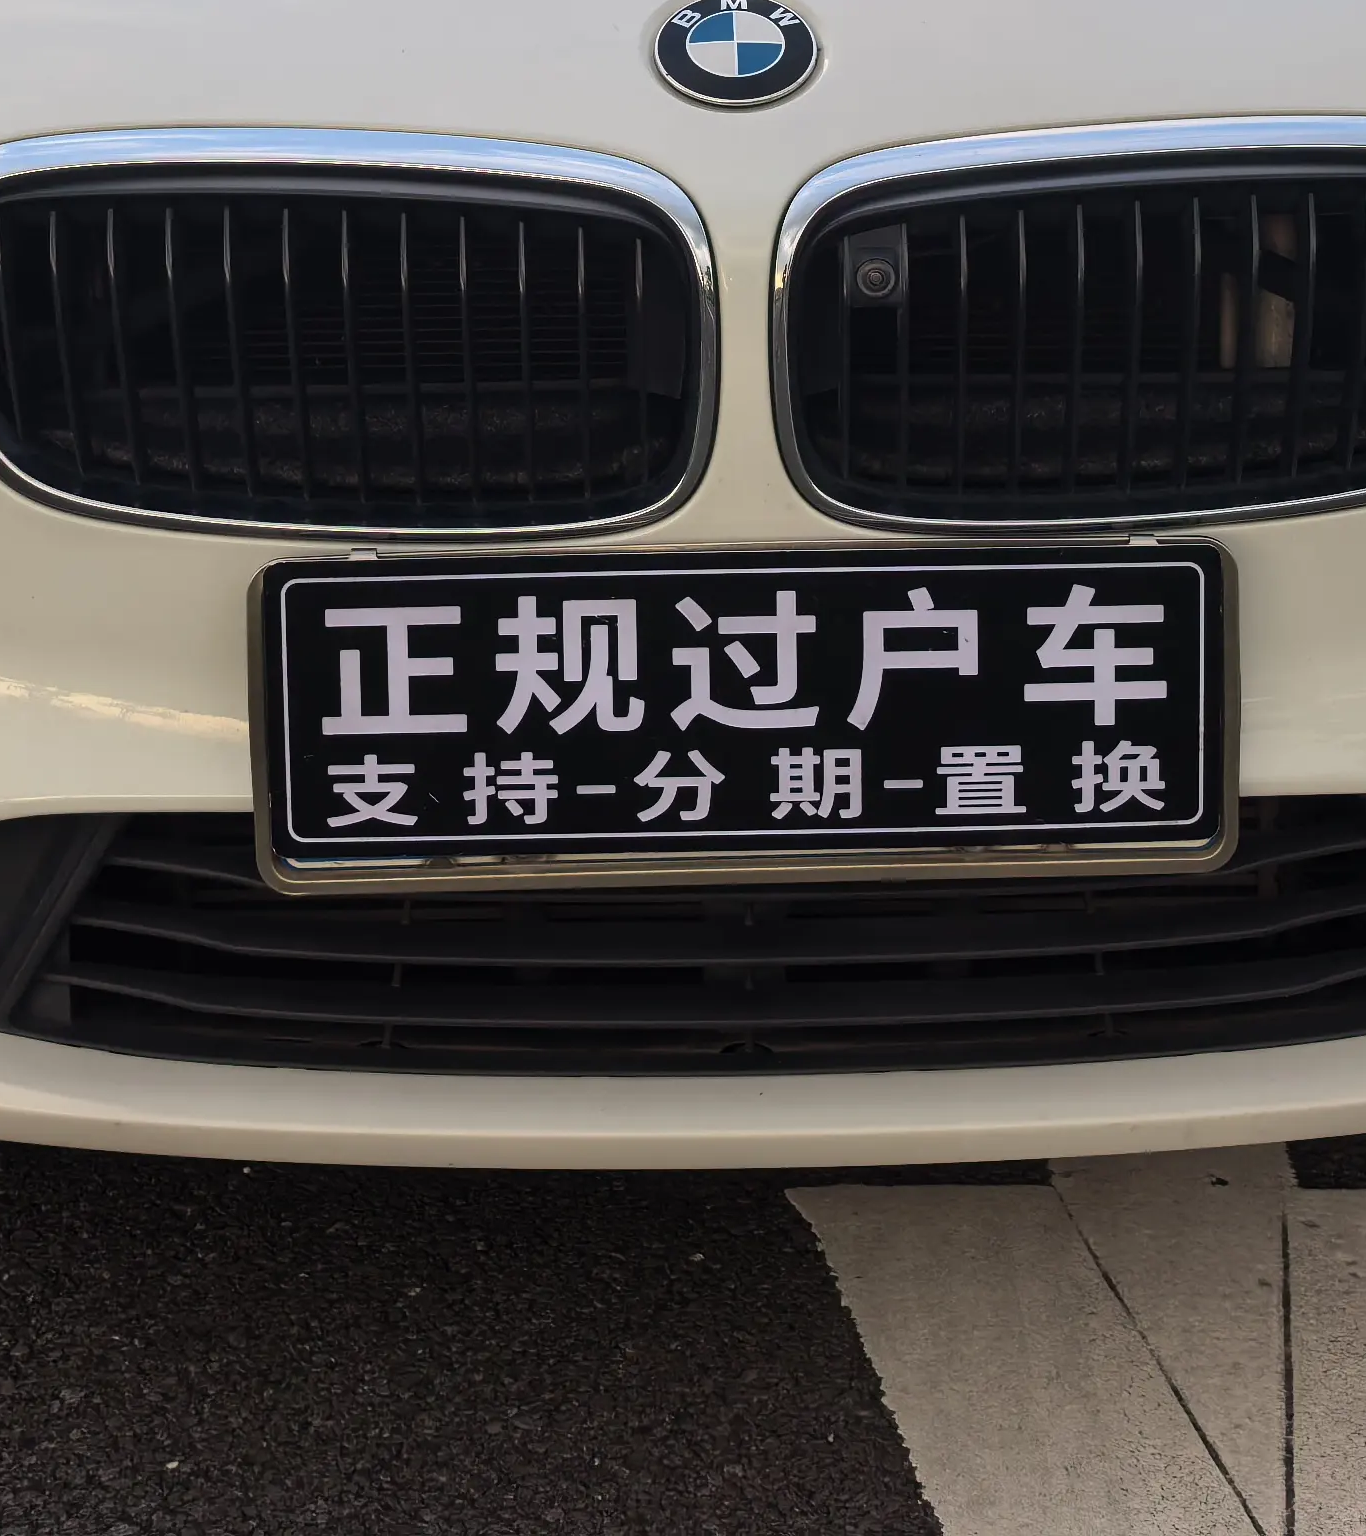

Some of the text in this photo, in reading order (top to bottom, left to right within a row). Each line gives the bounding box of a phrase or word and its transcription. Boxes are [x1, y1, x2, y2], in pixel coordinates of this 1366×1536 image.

[321, 584, 1168, 735] 正规过户车
